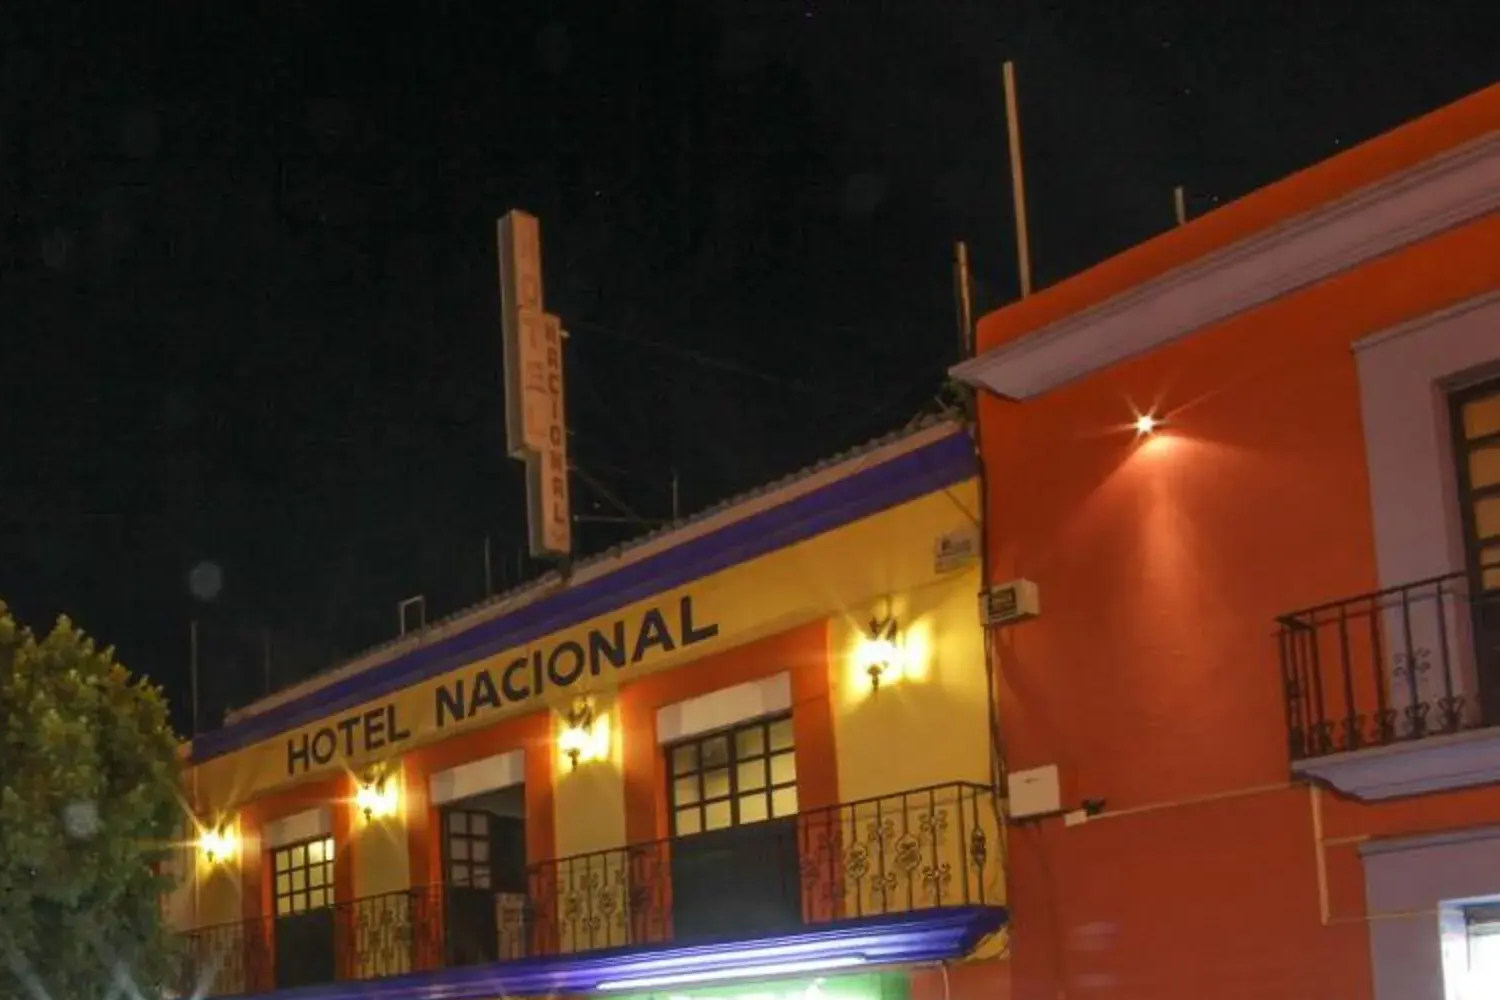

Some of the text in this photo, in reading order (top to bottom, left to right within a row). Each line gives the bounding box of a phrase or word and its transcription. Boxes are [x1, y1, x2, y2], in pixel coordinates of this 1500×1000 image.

[544, 320, 566, 525] NACIONAL
[287, 596, 719, 775] HOTEL NACIONAL
